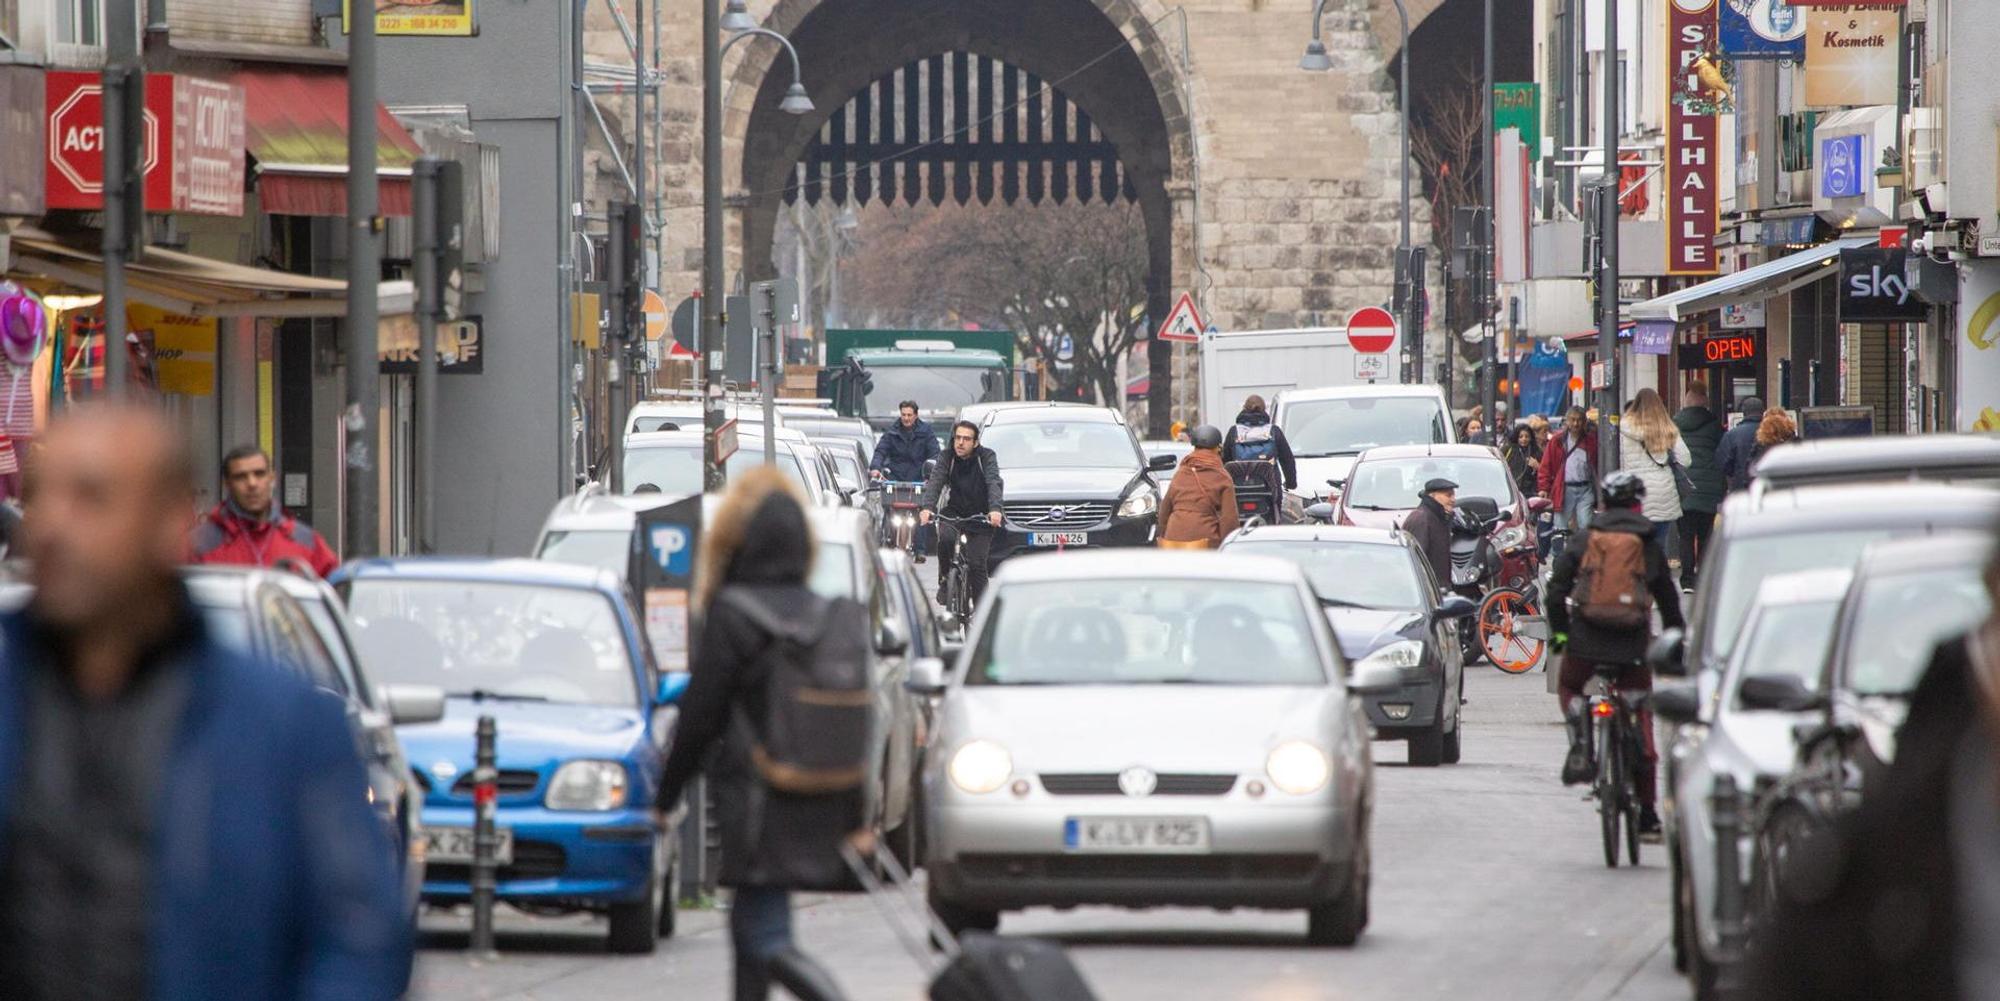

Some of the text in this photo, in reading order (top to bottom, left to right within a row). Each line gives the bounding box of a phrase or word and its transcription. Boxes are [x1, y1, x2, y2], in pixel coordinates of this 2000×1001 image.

[1848, 20, 1858, 29] &
[1823, 31, 1885, 48] Kosmetik
[63, 126, 104, 152] ACT
[1681, 25, 1706, 263] SPIELHALLE
[1851, 265, 1909, 305] sky
[155, 348, 184, 361] HOP
[1706, 338, 1754, 361] OPEN
[1037, 534, 1045, 544] K
